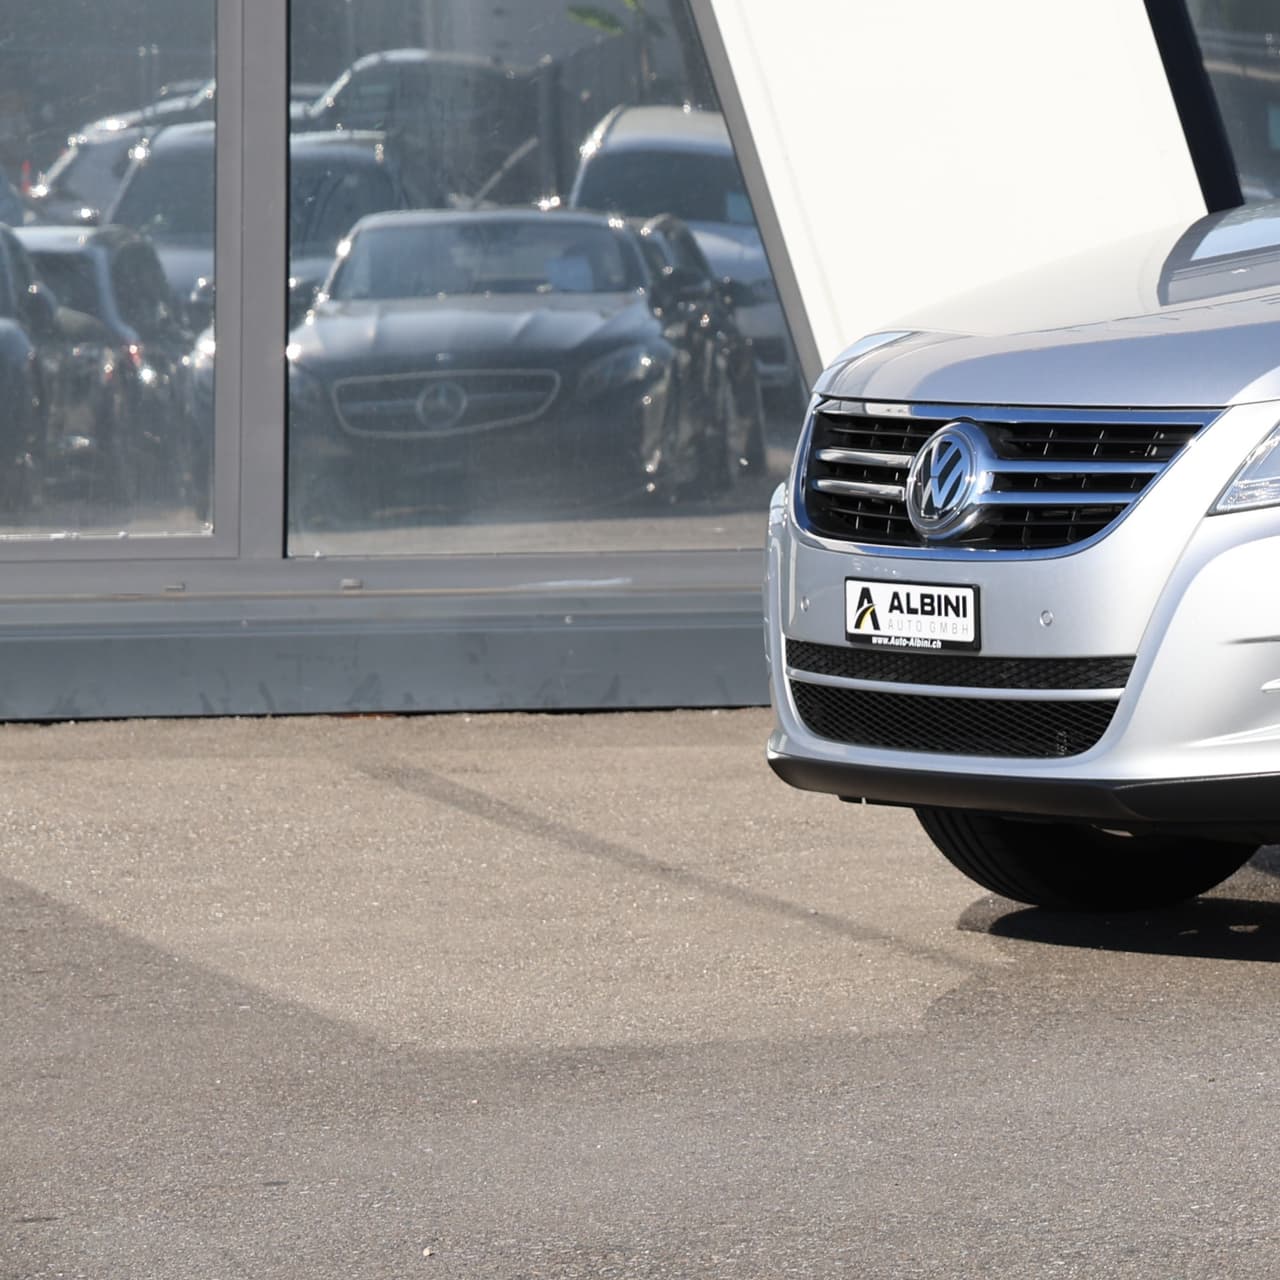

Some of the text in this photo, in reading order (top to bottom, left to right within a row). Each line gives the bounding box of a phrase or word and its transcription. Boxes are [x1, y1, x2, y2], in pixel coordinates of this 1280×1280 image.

[888, 591, 967, 618] ALBINI
[888, 618, 968, 635] AUTO GMBH
[872, 635, 942, 649] www.Auto-Albini.ch
